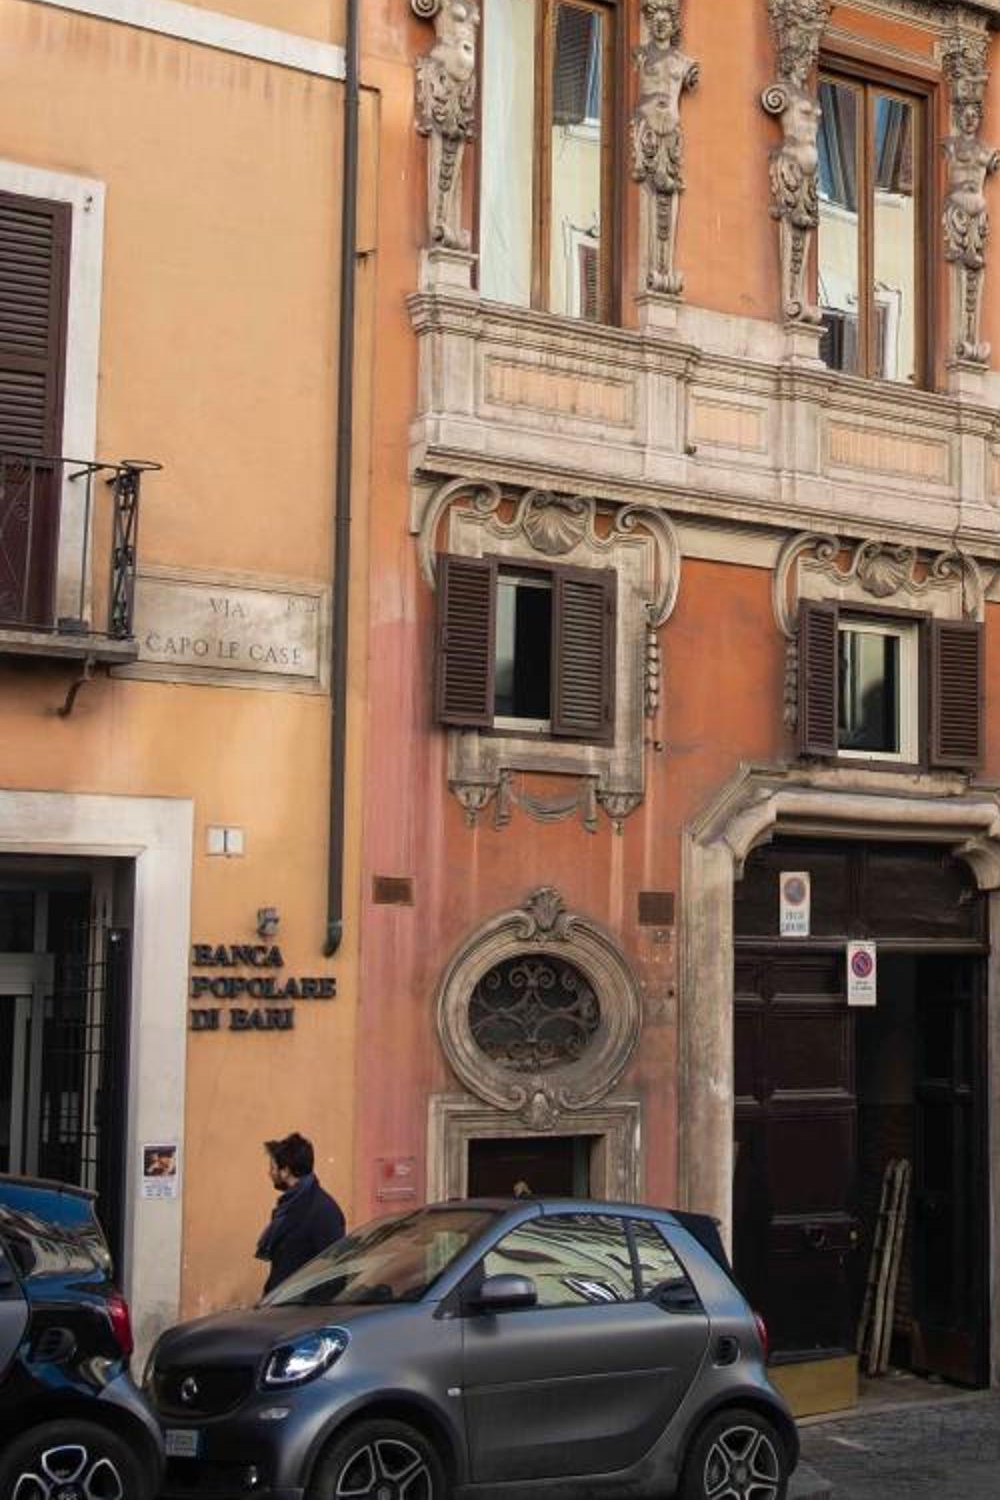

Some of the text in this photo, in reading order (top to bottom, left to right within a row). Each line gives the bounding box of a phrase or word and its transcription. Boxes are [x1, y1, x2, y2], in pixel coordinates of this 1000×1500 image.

[210, 597, 245, 618] VIA
[145, 632, 304, 666] CAPO LE CASE
[192, 945, 284, 967] BANCA
[190, 977, 337, 999] POPOLARE
[190, 1008, 294, 1031] DI BARI
